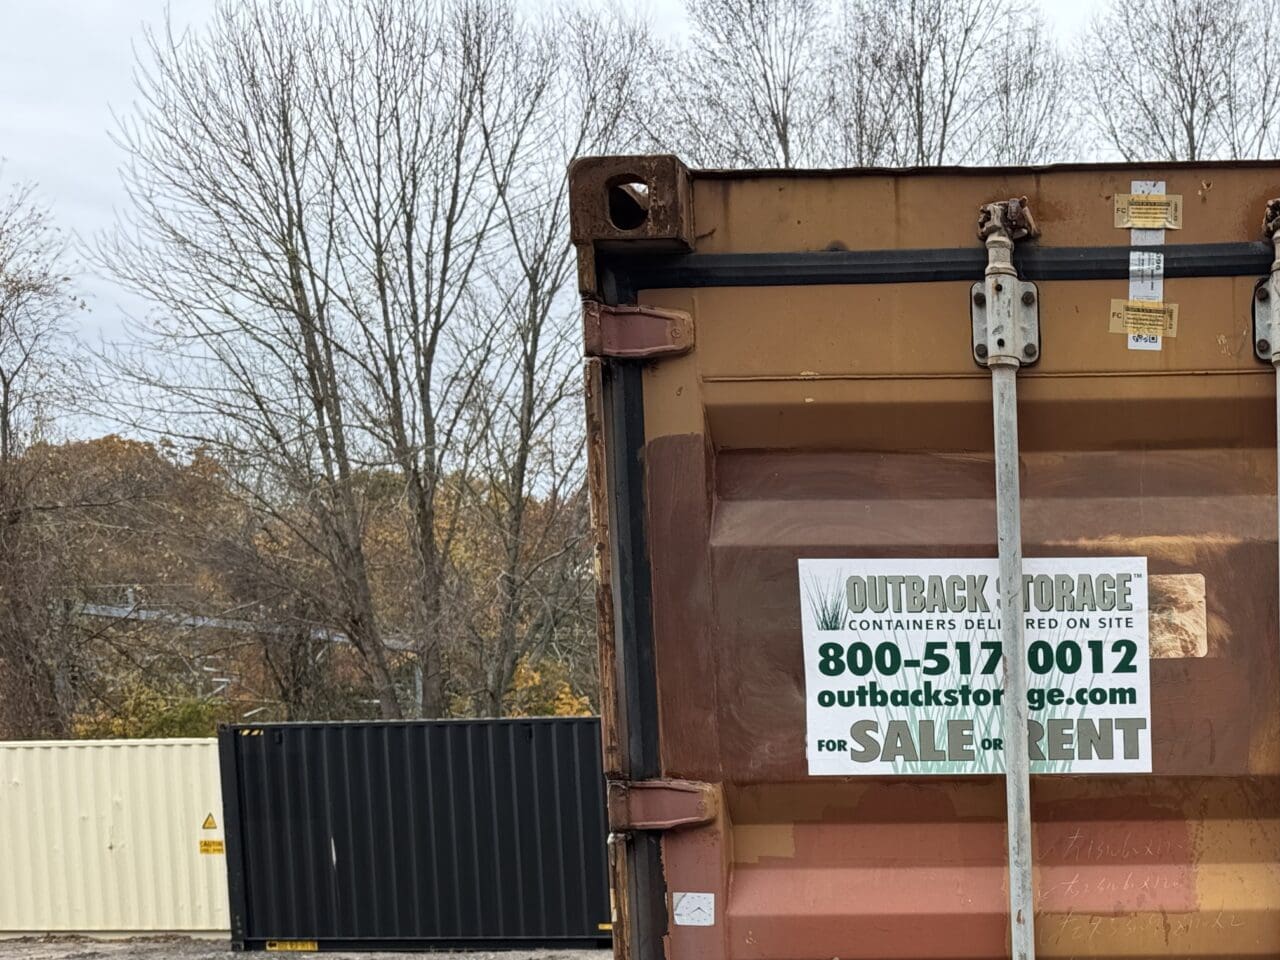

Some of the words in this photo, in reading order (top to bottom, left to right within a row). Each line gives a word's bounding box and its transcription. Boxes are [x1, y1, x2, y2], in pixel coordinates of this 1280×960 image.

[1111, 311, 1122, 319] FC
[846, 574, 990, 614] OUTBACK
[996, 573, 1134, 613] TORAGE
[848, 619, 957, 631] CONTAINERS
[965, 618, 1058, 631] DELIRED
[1066, 617, 1091, 630] ON
[1098, 617, 1134, 629] SITE
[818, 639, 1138, 677] 800-5170012
[817, 681, 1137, 711] outbackstorge.com
[817, 740, 848, 752] FOR
[850, 719, 975, 763] SALE
[981, 738, 1003, 751] OR
